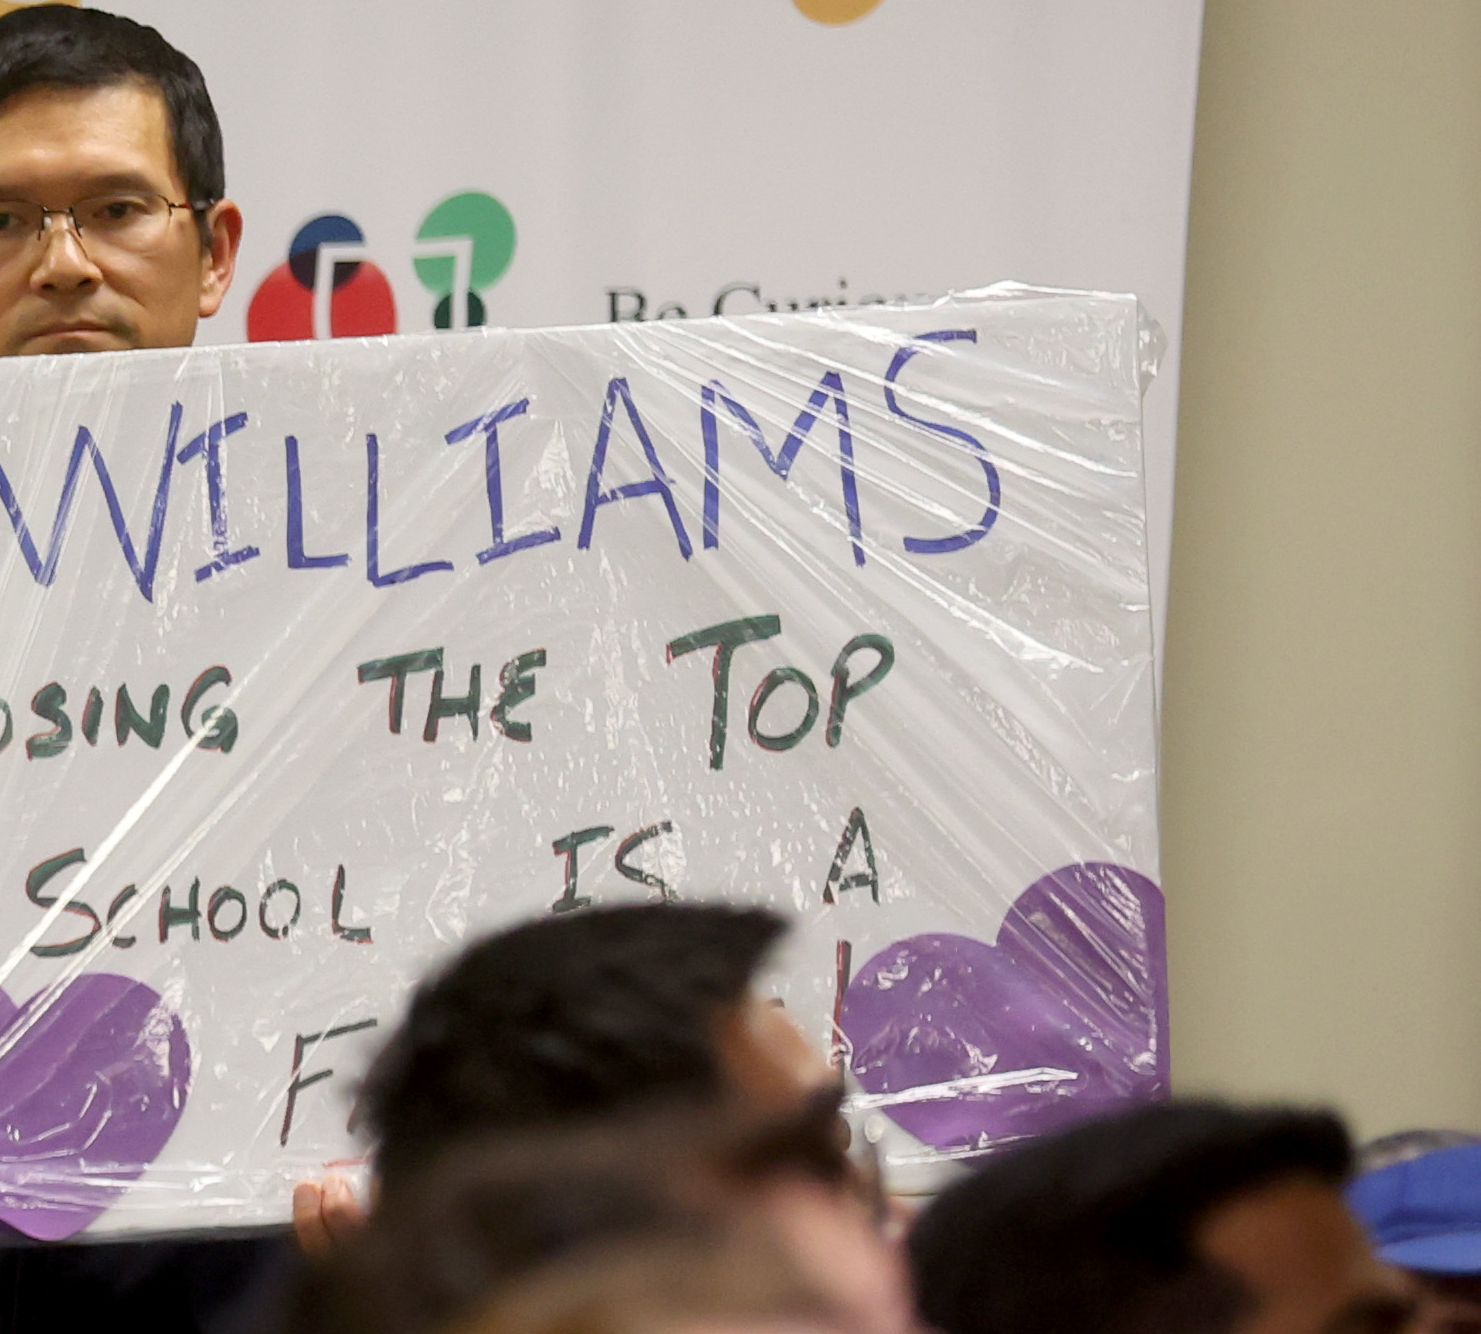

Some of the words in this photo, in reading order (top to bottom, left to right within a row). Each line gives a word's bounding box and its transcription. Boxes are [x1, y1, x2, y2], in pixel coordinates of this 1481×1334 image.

[358, 646, 548, 744] THE
[668, 614, 895, 772] TOP
[25, 846, 374, 958] SCHOOL
[550, 820, 676, 912] IS
[822, 807, 881, 906] A
